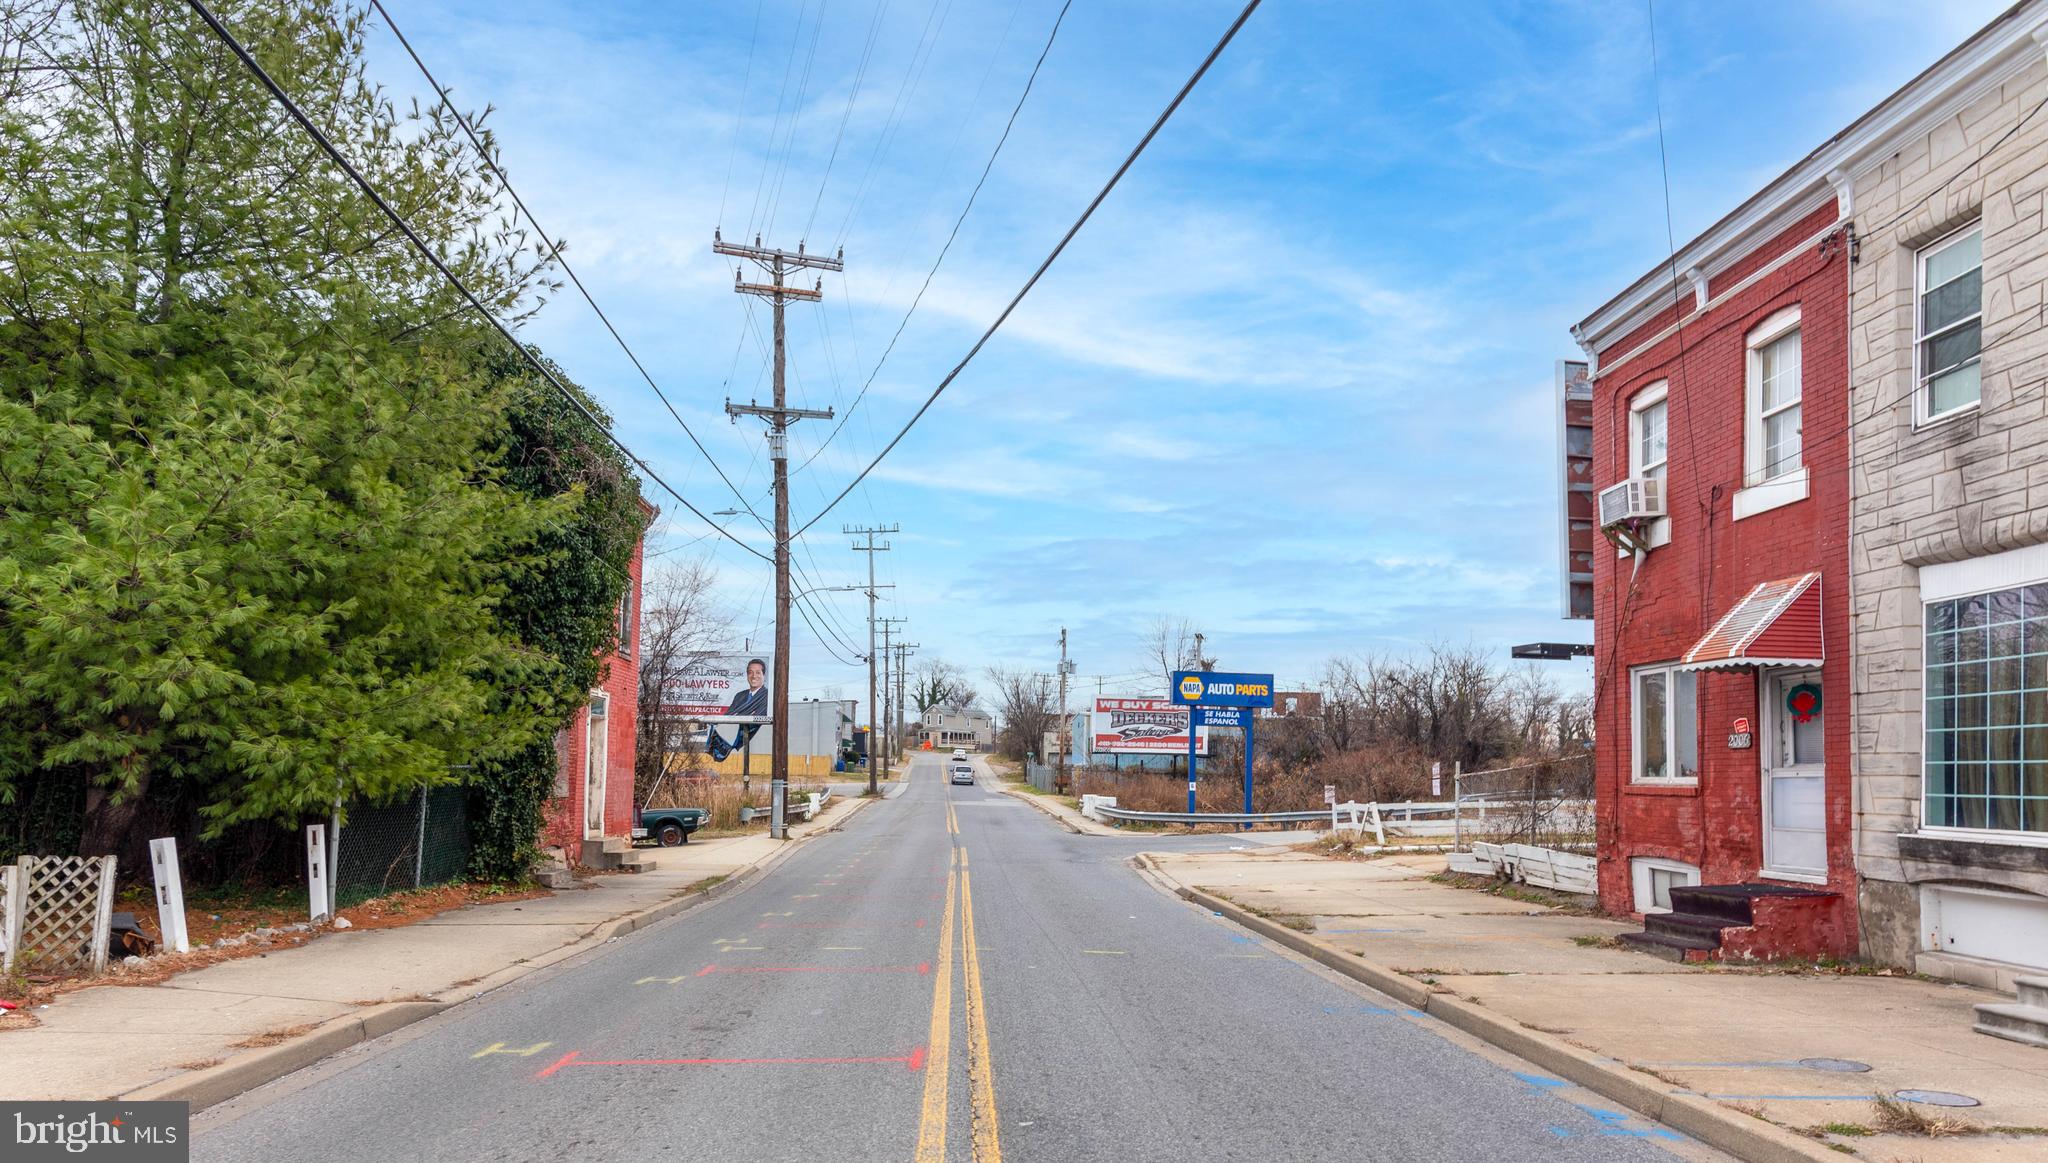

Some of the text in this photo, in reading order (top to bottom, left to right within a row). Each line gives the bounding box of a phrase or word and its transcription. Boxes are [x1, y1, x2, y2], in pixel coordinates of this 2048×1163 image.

[1183, 682, 1200, 693] NAPA
[1207, 683, 1269, 697] AUTO PARTS
[1099, 700, 1120, 709] WE
[1122, 701, 1149, 709] BUY
[1151, 702, 1190, 711] SCRA
[1204, 710, 1214, 718] SE
